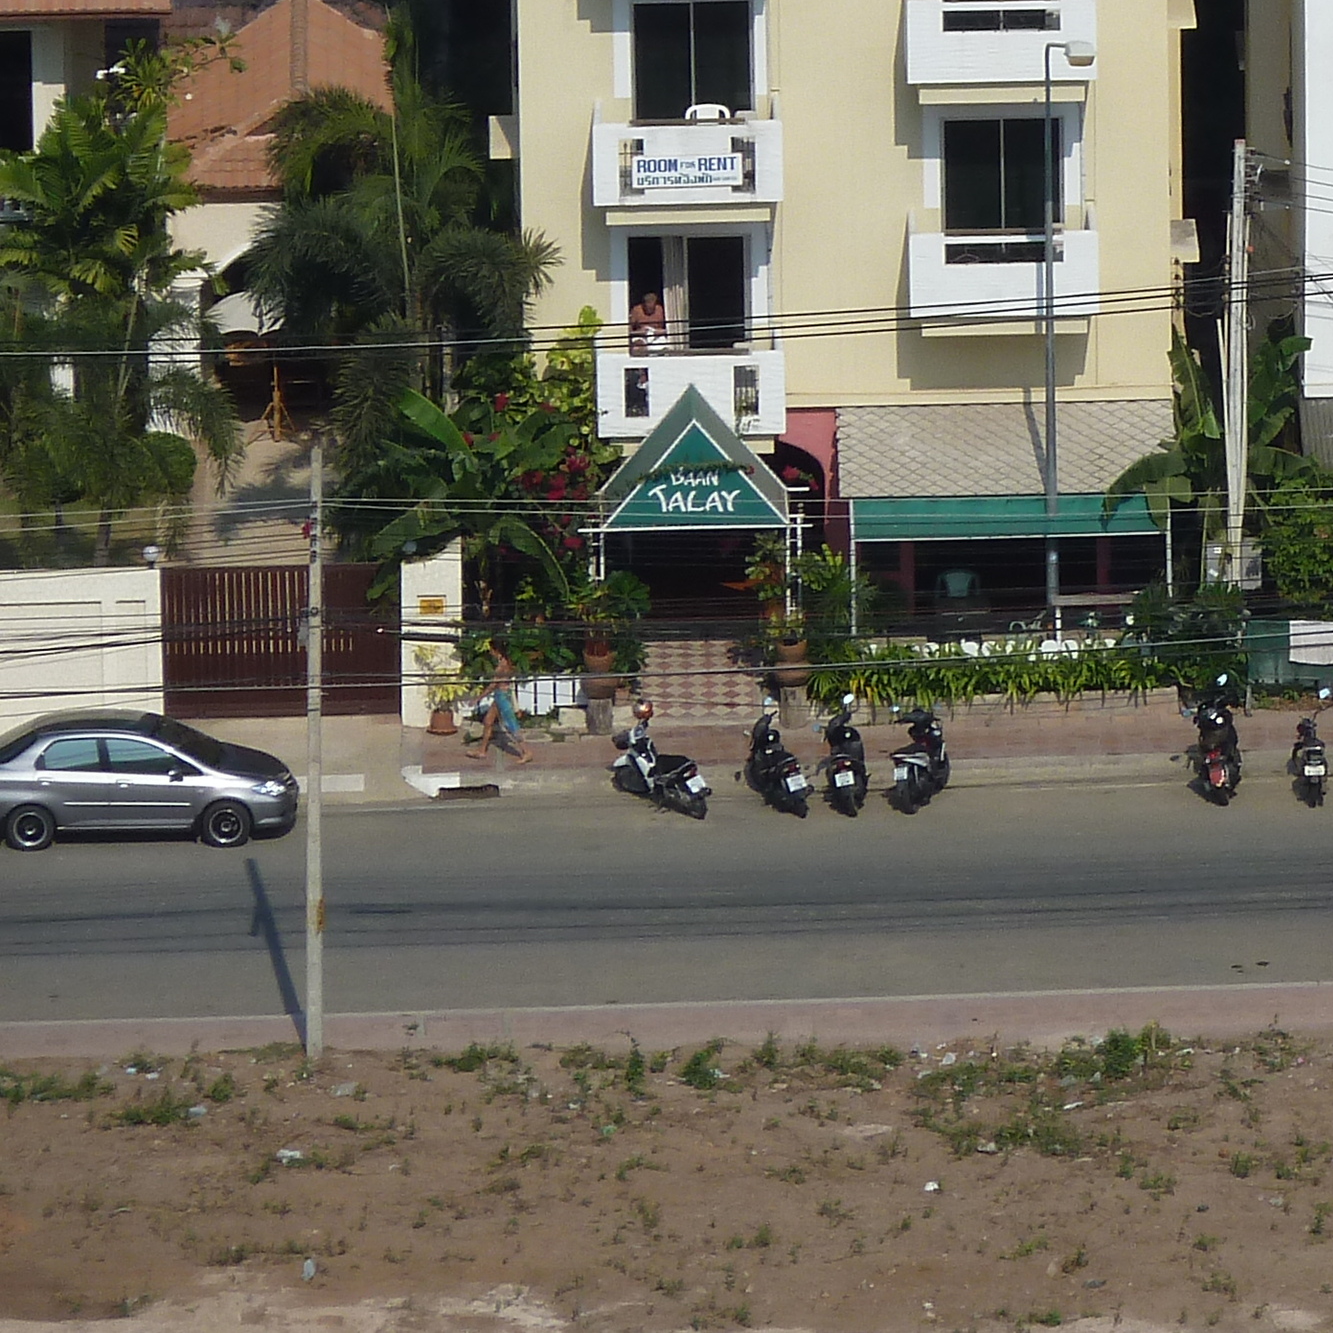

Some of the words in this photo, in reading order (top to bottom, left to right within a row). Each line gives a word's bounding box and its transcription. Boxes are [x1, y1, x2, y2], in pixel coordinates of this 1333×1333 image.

[637, 159, 678, 173] ROOM
[680, 161, 696, 169] FOR
[698, 156, 737, 171] RENT
[670, 467, 719, 486] BAAN
[647, 484, 741, 513] TALAY
